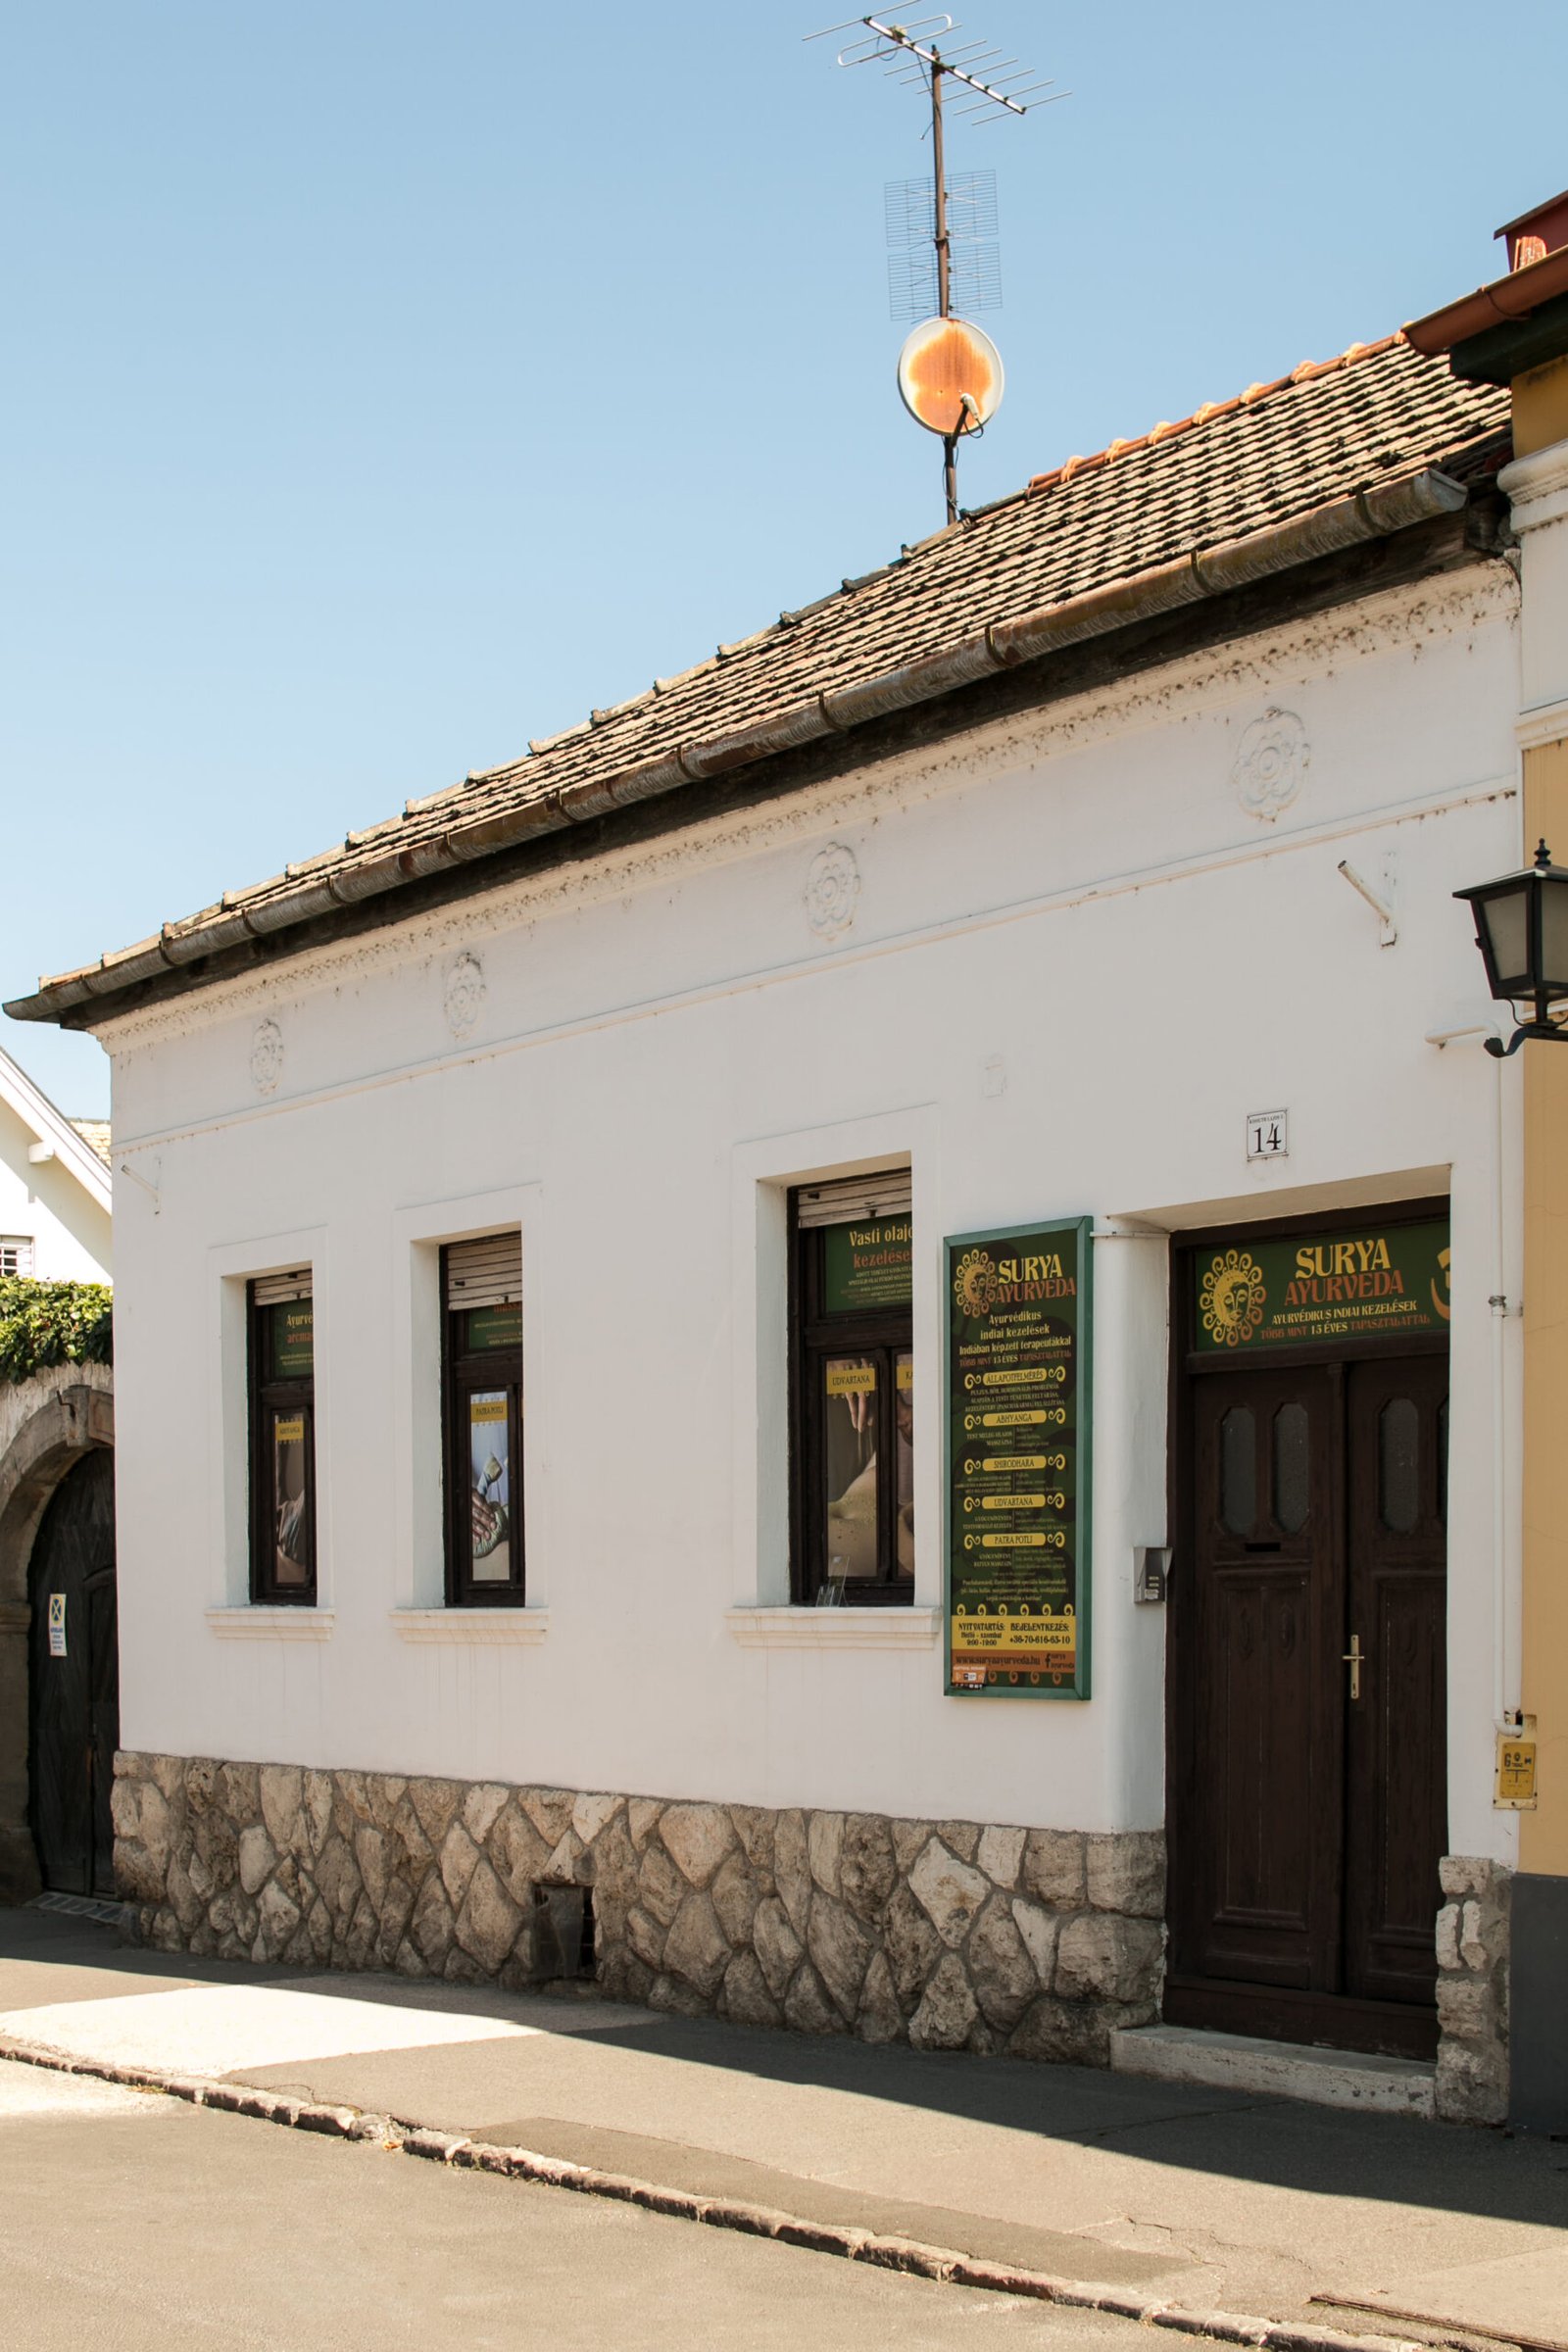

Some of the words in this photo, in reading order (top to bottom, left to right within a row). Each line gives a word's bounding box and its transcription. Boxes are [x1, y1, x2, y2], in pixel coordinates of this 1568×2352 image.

[1253, 1122, 1282, 1153] 14
[849, 1227, 880, 1247] Vasti
[998, 1253, 1062, 1284] SURYA
[1295, 1239, 1391, 1280] SURYA
[996, 1277, 1076, 1303] AYURVEDA
[1284, 1269, 1404, 1306] AYURVEDA
[286, 1311, 314, 1329] Ayurvé
[989, 1310, 1042, 1325] Ayurvédikus
[1272, 1308, 1332, 1325] AYURVÉDIKUS
[1333, 1305, 1360, 1319] INDIAI
[1361, 1298, 1418, 1316] KEZELÉSEK
[980, 1328, 1004, 1341] indiai
[1005, 1324, 1050, 1339] kezelések
[1311, 1324, 1322, 1335] 15
[1324, 1321, 1348, 1334] ÉVES
[959, 1344, 990, 1355] Indiában
[1020, 1336, 1071, 1350] terapeutákkal
[996, 1413, 1033, 1424] ABHYANGA
[994, 1457, 1035, 1469] SHIRODHARA
